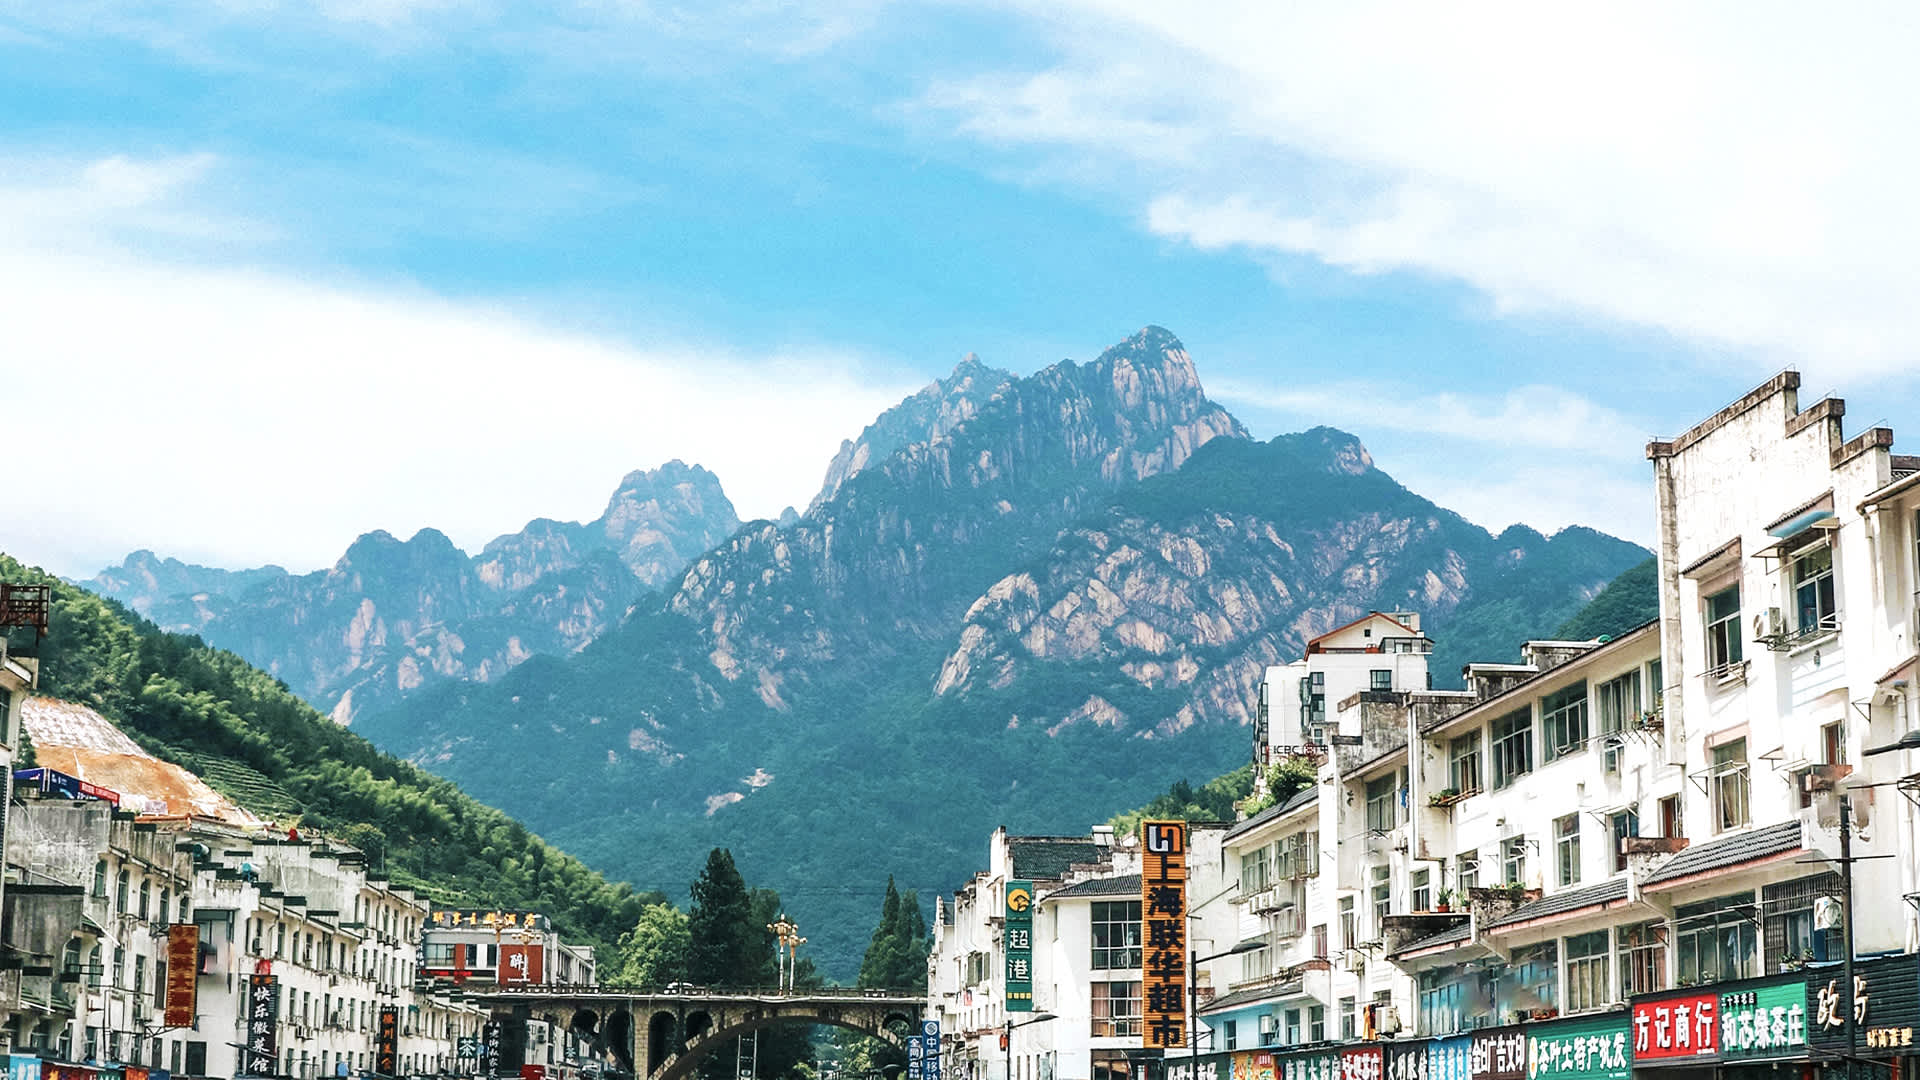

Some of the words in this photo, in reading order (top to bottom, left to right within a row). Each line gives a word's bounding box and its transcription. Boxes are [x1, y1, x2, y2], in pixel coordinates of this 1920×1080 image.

[1273, 745, 1300, 754] ICBC
[1009, 929, 1030, 979] 超港
[1148, 854, 1184, 1047] 上海联华超市
[250, 986, 271, 1073] 快乐徽菜馆
[459, 1038, 476, 1057] 茶
[1635, 1001, 1713, 1052] 方记商行
[1538, 1031, 1627, 1074] 茶叶土特产批发
